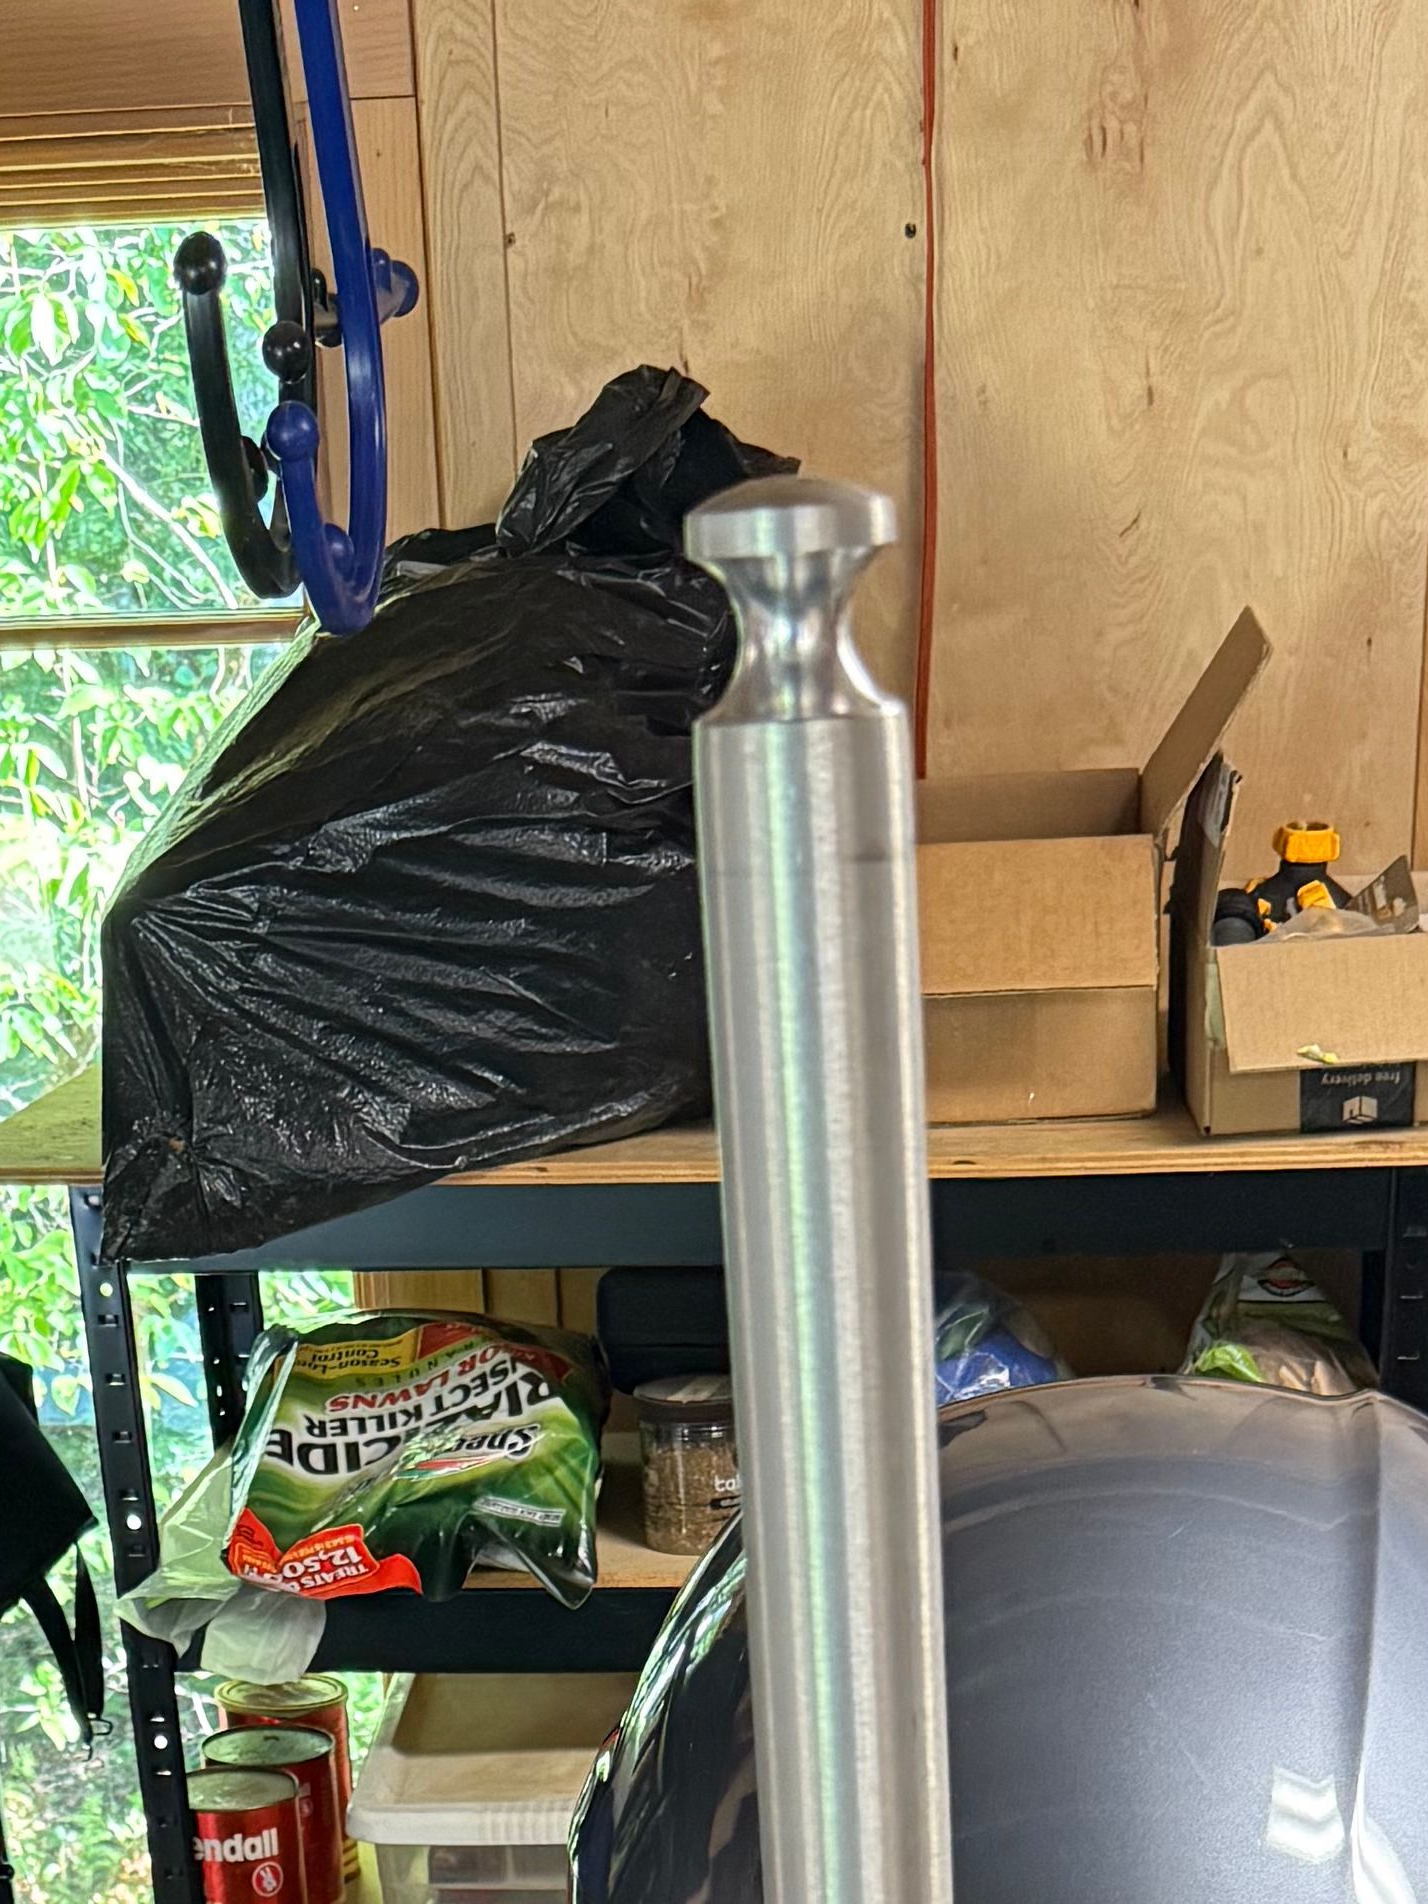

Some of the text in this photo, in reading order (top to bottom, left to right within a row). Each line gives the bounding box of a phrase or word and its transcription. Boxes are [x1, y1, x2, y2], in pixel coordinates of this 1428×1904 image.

[1320, 1070, 1400, 1087] free delivery
[310, 1348, 380, 1364] Control
[328, 1344, 509, 1413] OR LAWNS
[303, 1404, 424, 1438] KILLER
[301, 1563, 369, 1590] TREATS
[192, 1827, 280, 1862] endall
